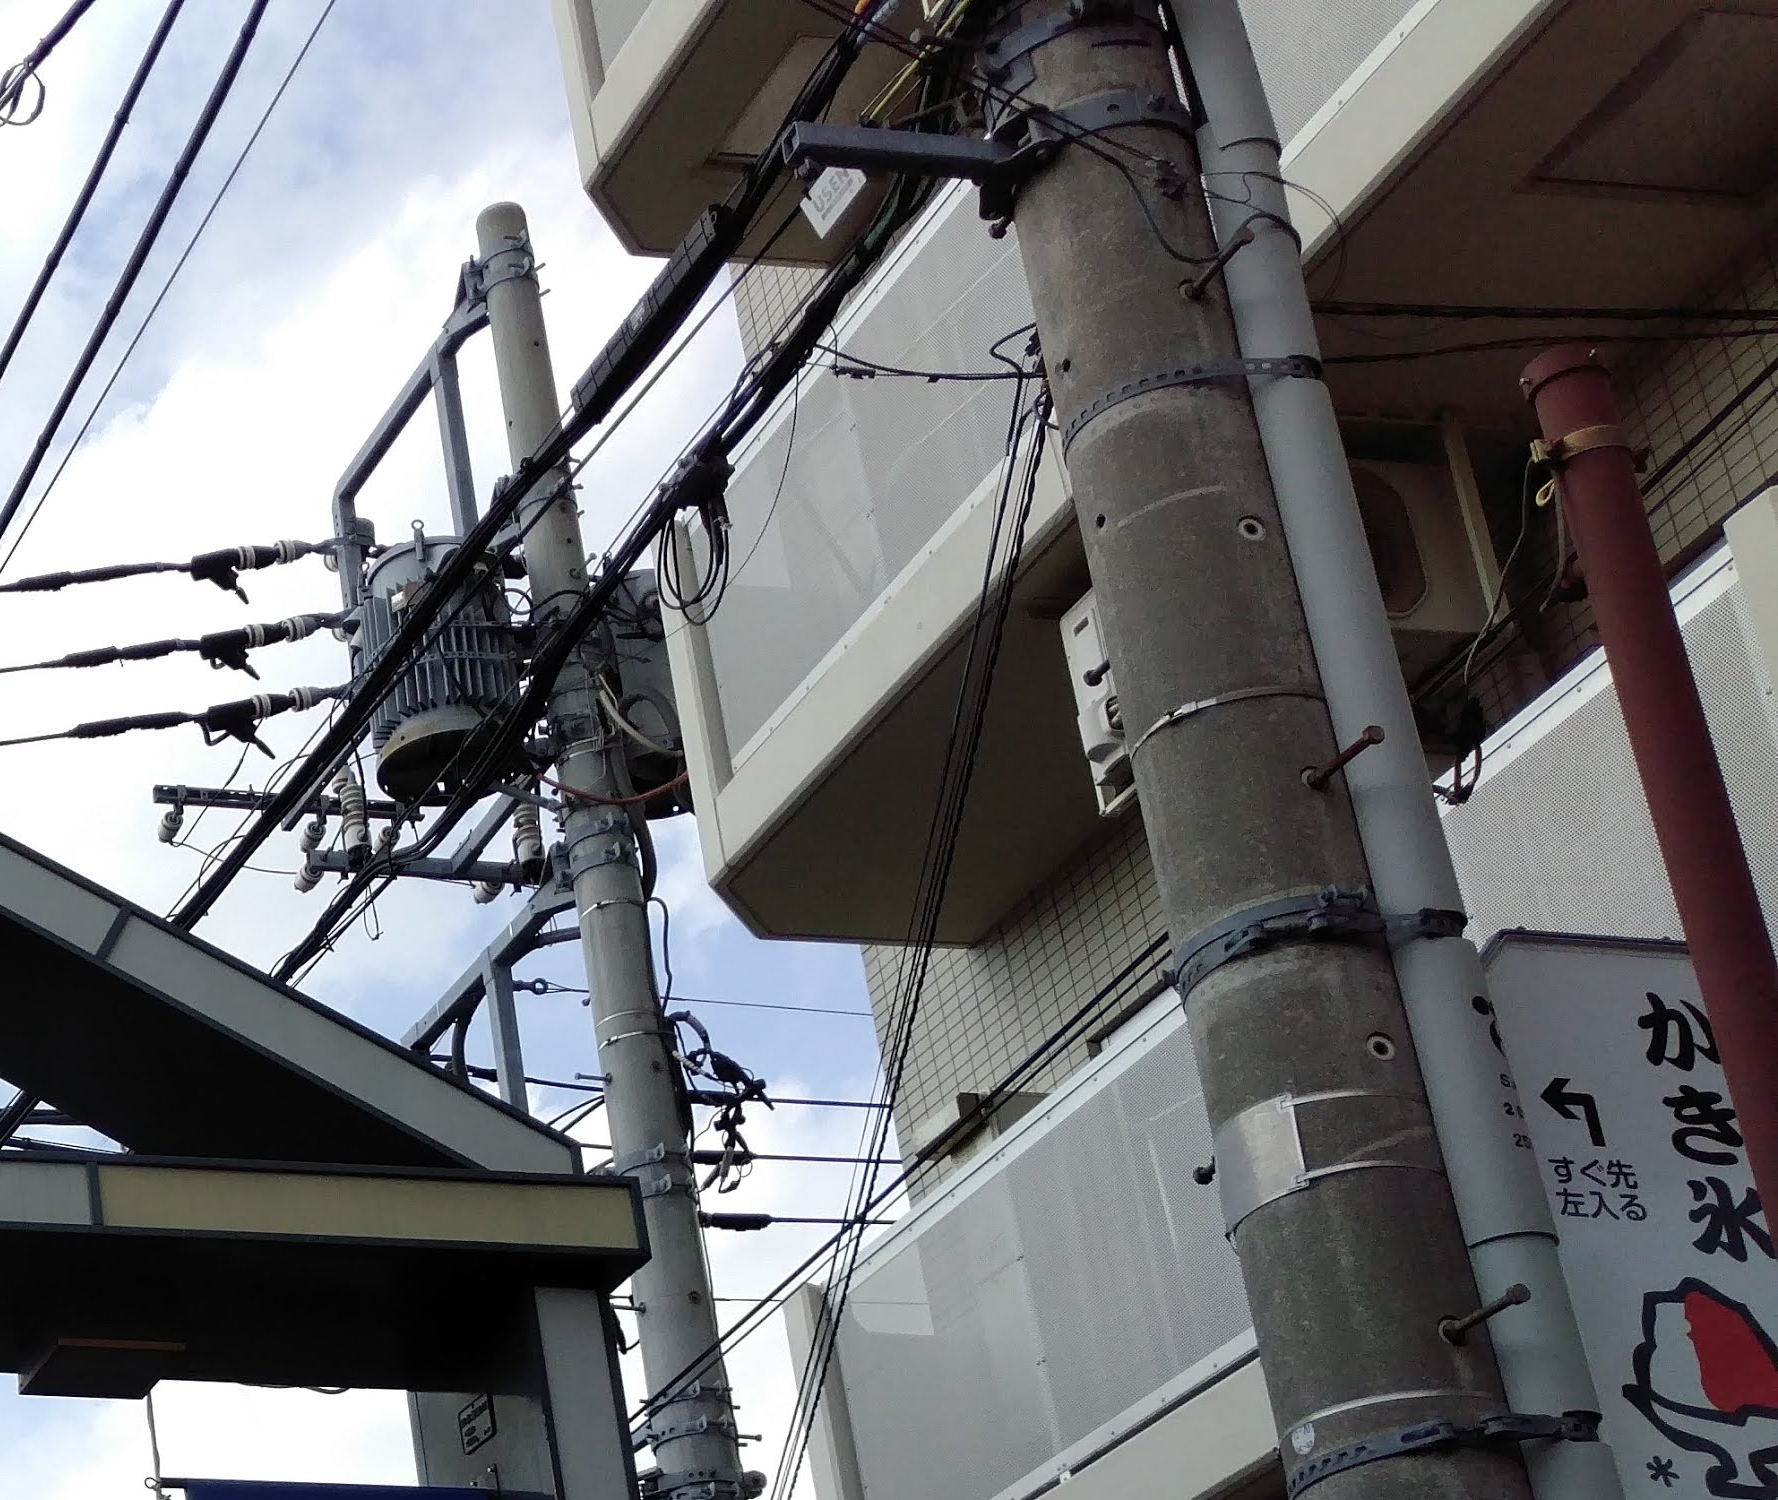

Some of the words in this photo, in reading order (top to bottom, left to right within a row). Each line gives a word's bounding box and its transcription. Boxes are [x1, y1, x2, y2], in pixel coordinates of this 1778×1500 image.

[812, 169, 850, 213] USEN
[1636, 991, 1777, 1263] かき氷
[1547, 1156, 1639, 1190] すぐ先
[1555, 1189, 1648, 1221] 左入る
